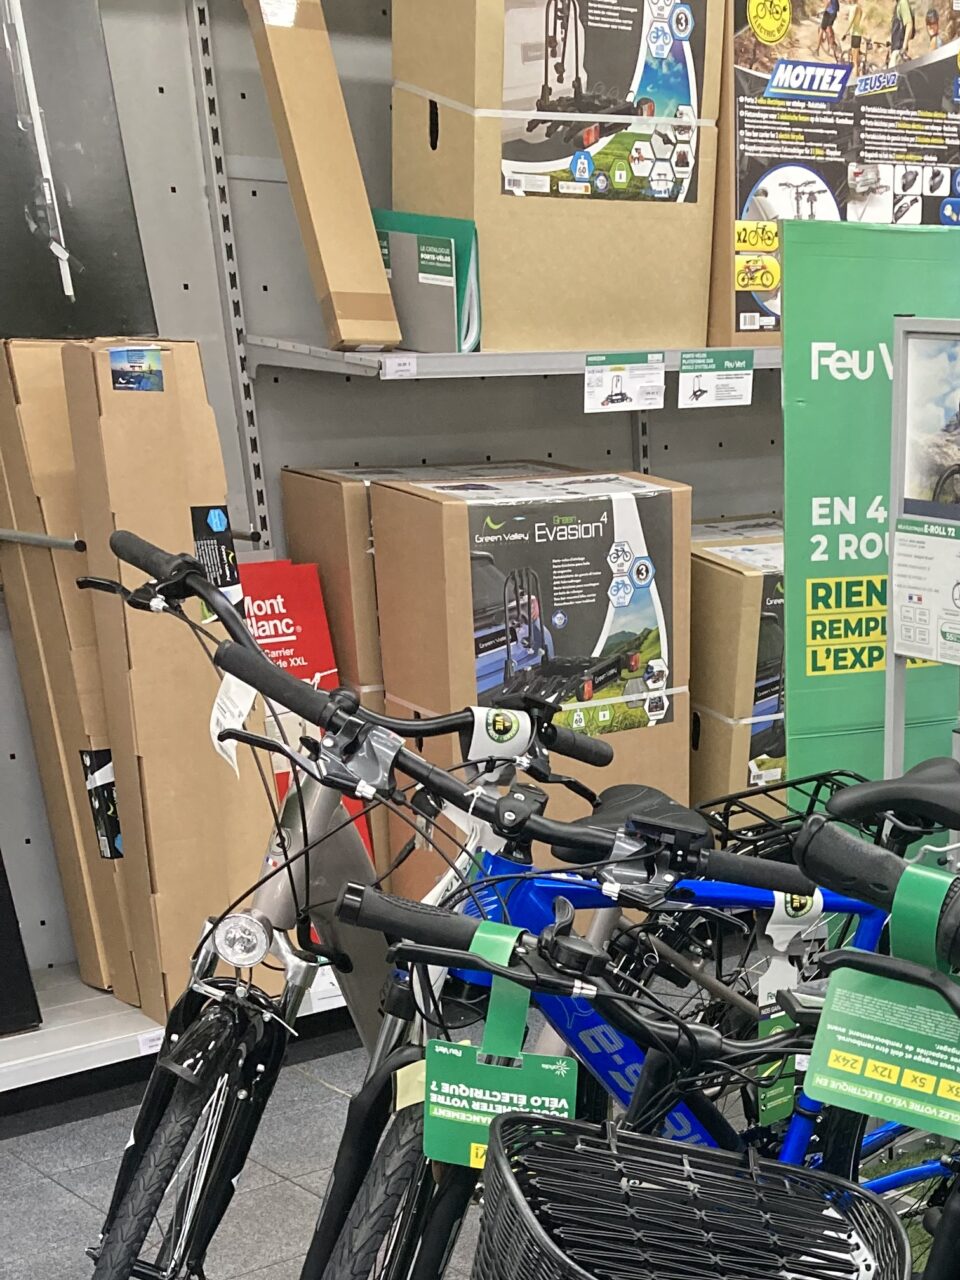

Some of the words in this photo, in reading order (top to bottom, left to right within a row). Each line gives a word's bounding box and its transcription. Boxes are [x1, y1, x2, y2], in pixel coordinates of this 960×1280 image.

[679, 14, 685, 29] 3
[772, 63, 847, 92] MOTTEZ
[737, 230, 747, 243] x2
[811, 342, 875, 380] Feu
[812, 497, 856, 526] EN
[866, 496, 887, 523] 4
[535, 520, 603, 542] Evasion
[600, 512, 608, 524] 4
[553, 516, 576, 524] Green
[924, 524, 946, 535] E-ROLL
[948, 528, 955, 536] 72
[475, 534, 502, 543] Green
[503, 533, 529, 541] Valley
[810, 534, 829, 561] 2
[638, 566, 647, 579] 3
[812, 618, 887, 640] REMPL
[289, 658, 308, 666] XXL
[574, 717, 583, 725] 60
[832, 1054, 859, 1070] 24x
[870, 1064, 893, 1079] 12x
[430, 1080, 438, 1090] ?
[815, 1076, 828, 1086] EN
[910, 1074, 928, 1088] 5x
[441, 1082, 526, 1104] ÉLECTRIQUE
[830, 1080, 883, 1102] ÉLECTRIQUE
[430, 1093, 469, 1108] VOTRE
[531, 1095, 569, 1109] VÉLO
[884, 1095, 905, 1108] VÉLO
[909, 1102, 936, 1114] VOTRE
